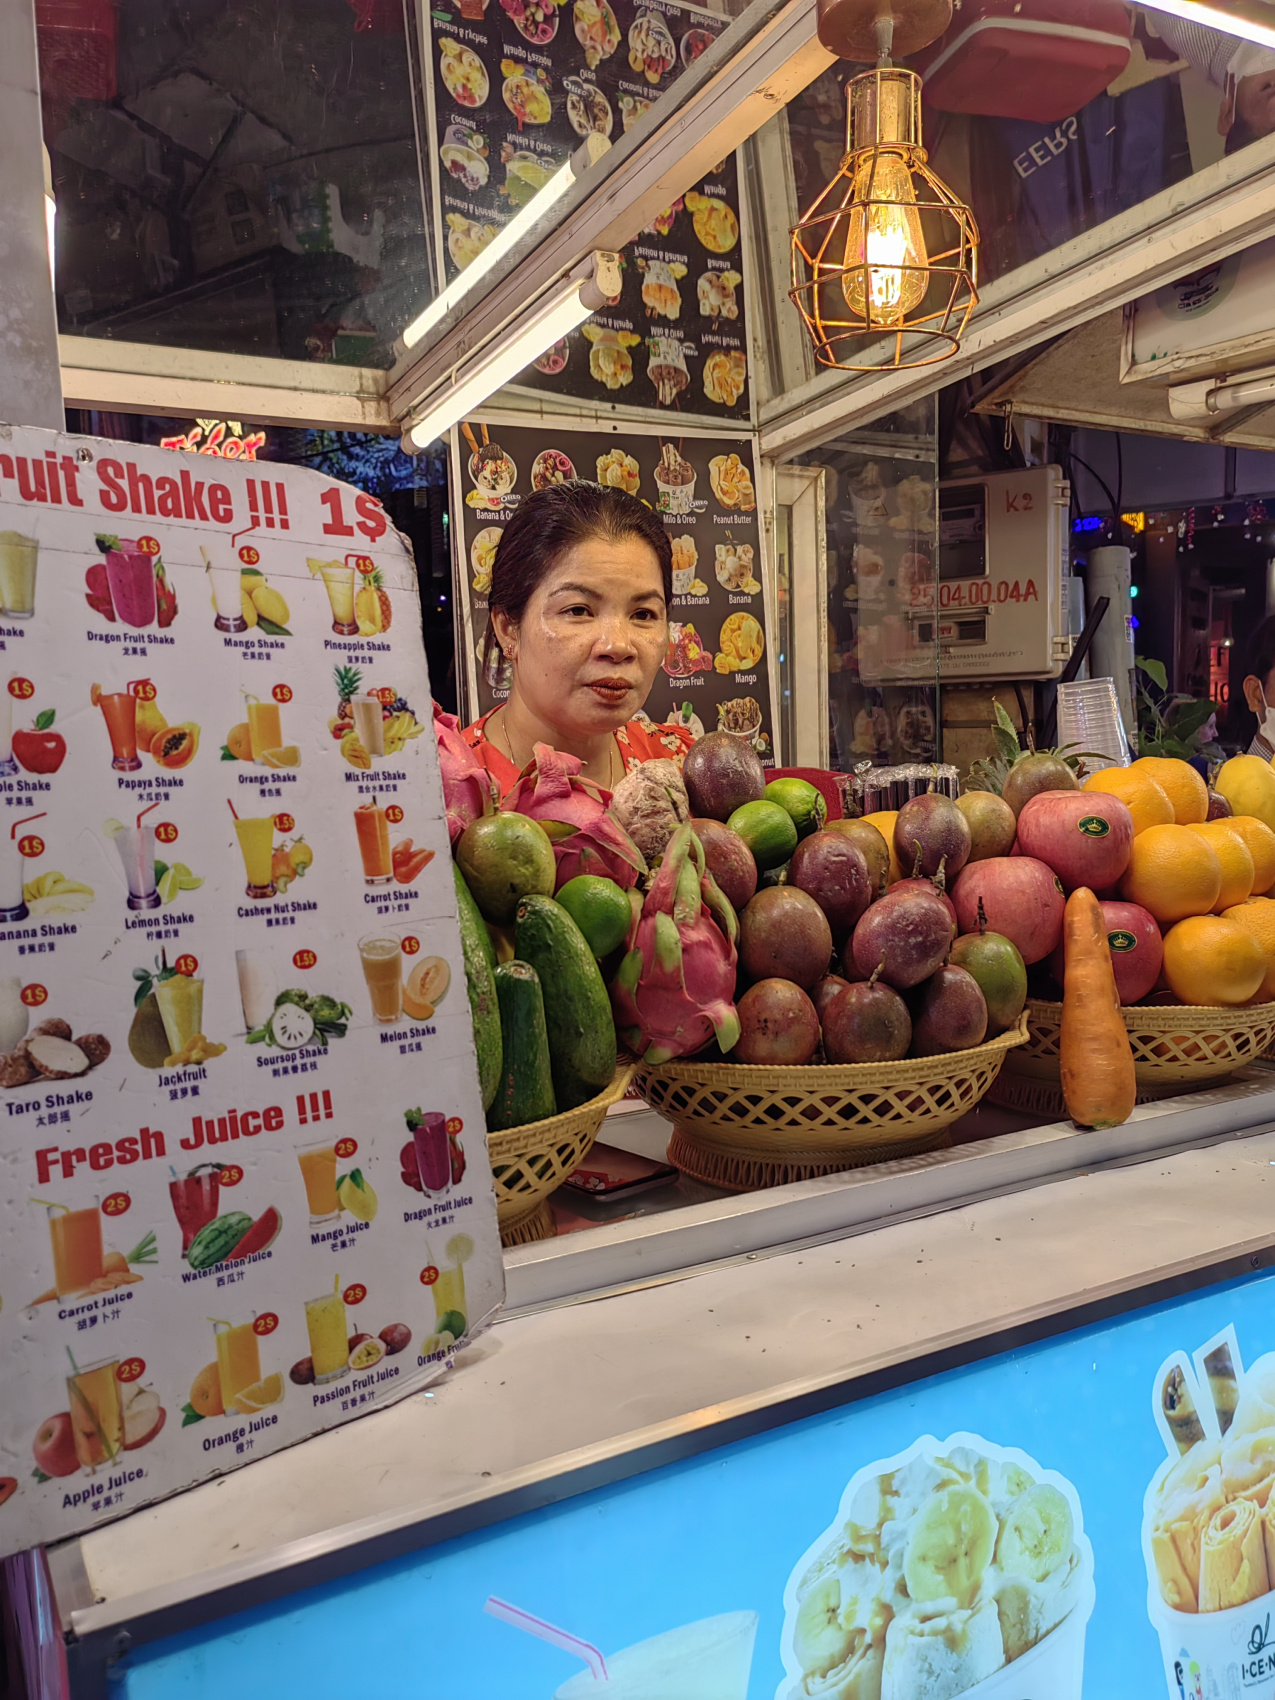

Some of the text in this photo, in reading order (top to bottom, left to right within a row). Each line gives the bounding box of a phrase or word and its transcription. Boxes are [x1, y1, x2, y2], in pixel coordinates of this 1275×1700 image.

[96, 458, 235, 524] Shake
[246, 478, 290, 530] !!!
[320, 487, 388, 543] 1$
[476, 509, 505, 520] Banana &
[663, 515, 697, 524] Milo & Oreo
[713, 514, 752, 524] Peanut Butter
[140, 539, 159, 552] 1$
[241, 549, 258, 562] 1$
[358, 559, 372, 572] 1$
[687, 595, 710, 605] Banana
[729, 595, 752, 604] Banana
[87, 631, 175, 645] Dragon Fruit Shake
[224, 638, 286, 649] Mango Shake
[324, 640, 391, 652] Pineapple Shake
[669, 676, 705, 689] Dragon Fruit
[735, 673, 757, 685] Mango
[12, 681, 31, 697] 1$
[136, 684, 155, 699] 1$
[275, 687, 291, 700] 1$
[378, 690, 396, 703] 1.5$
[118, 777, 184, 791] Papaya Shake
[238, 773, 297, 786] Orange Shake
[345, 771, 407, 783] Mix Fruit Shake
[17, 780, 51, 792] Shake
[387, 808, 402, 821] 1$
[275, 817, 294, 830] 1.5$
[158, 826, 175, 840] 1$
[22, 839, 42, 853] 1$
[364, 889, 419, 904] Carrot Shake
[237, 900, 318, 918] Cashew Nut Shake
[125, 911, 194, 930] Lemon Shake
[41, 923, 77, 937] Shake
[404, 938, 418, 952] 1$
[179, 957, 195, 971] 1$
[295, 952, 315, 967] 1.5$
[25, 987, 45, 1002] 1$
[380, 1025, 436, 1044] Melon Shake
[256, 1046, 329, 1068] Soursop Shake
[158, 1067, 208, 1088] Jackfruit
[6, 1090, 93, 1116] Taro Shake
[447, 1119, 462, 1131] 2$
[35, 1089, 333, 1184] Fresh Juice !!!
[338, 1141, 354, 1153] 2$
[222, 1168, 239, 1182] 2$
[107, 1197, 126, 1211] 2$
[403, 1195, 473, 1223] Dragon Fruit Juice
[310, 1221, 370, 1245] Mango Juice
[215, 1258, 246, 1275] Melon
[247, 1250, 273, 1265] Juice
[216, 1271, 245, 1288] 西瓜汁
[422, 1268, 437, 1282] 2$
[346, 1288, 363, 1302] 2$
[58, 1290, 133, 1320] Carrot Juice
[256, 1316, 275, 1332] 2$
[417, 1348, 447, 1367] Orange
[120, 1362, 141, 1379] 2$
[313, 1366, 400, 1408] Passion Fruit Juice
[202, 1413, 279, 1452] Orange Juice
[62, 1466, 144, 1509] Apple Juice
